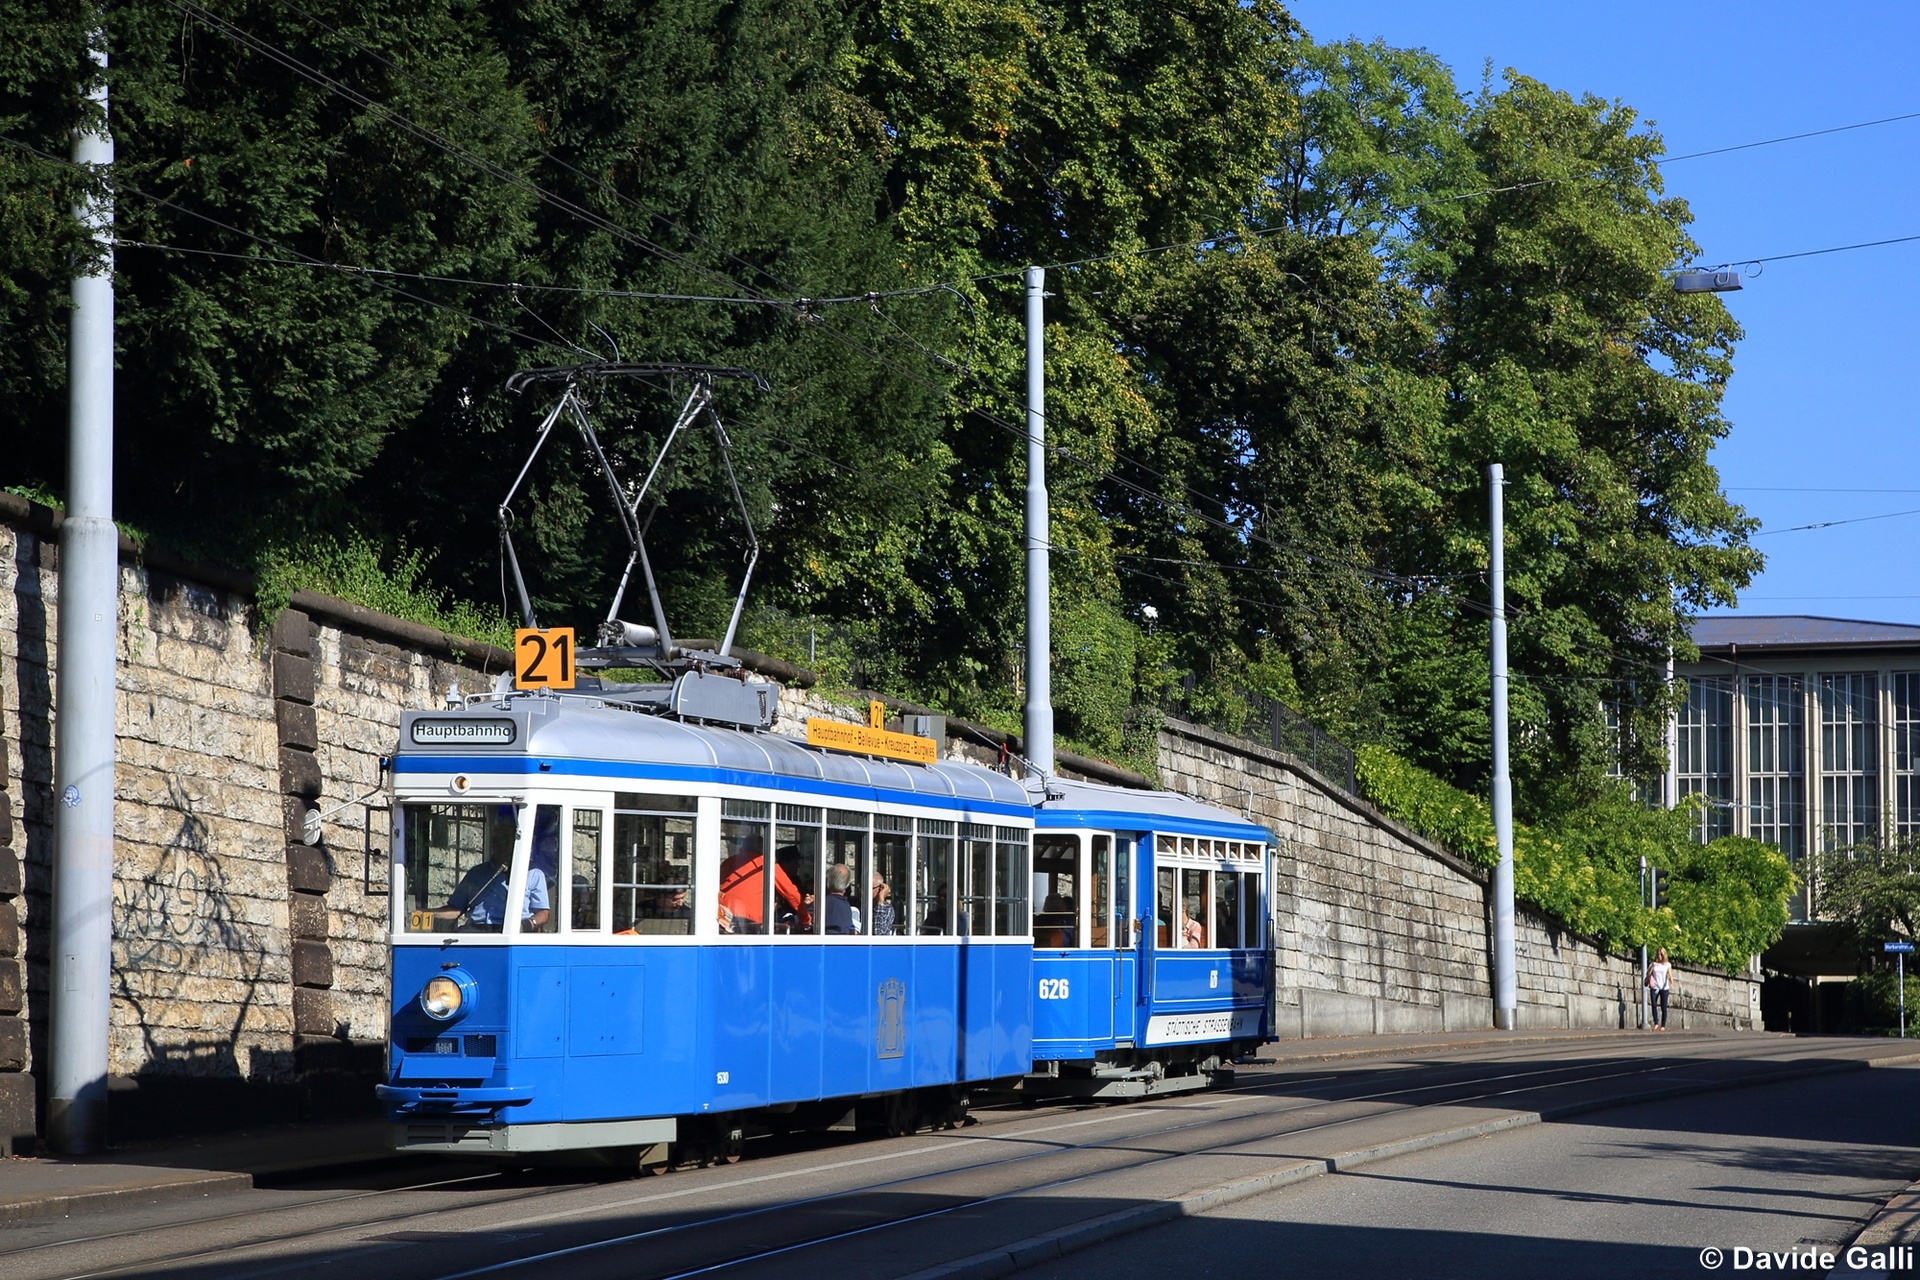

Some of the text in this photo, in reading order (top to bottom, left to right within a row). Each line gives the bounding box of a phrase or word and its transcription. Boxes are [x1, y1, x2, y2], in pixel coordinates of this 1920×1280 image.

[521, 634, 569, 682] 21
[874, 705, 883, 729] 21
[813, 723, 854, 744] Hauptbahnhof
[858, 730, 880, 748] Bellevue
[884, 736, 911, 755] Kreuzplatz
[914, 740, 935, 760] Burgwies
[1039, 978, 1069, 1000] 626
[1165, 1017, 1244, 1036] STÄDTISCHE STRASSENBAHN
